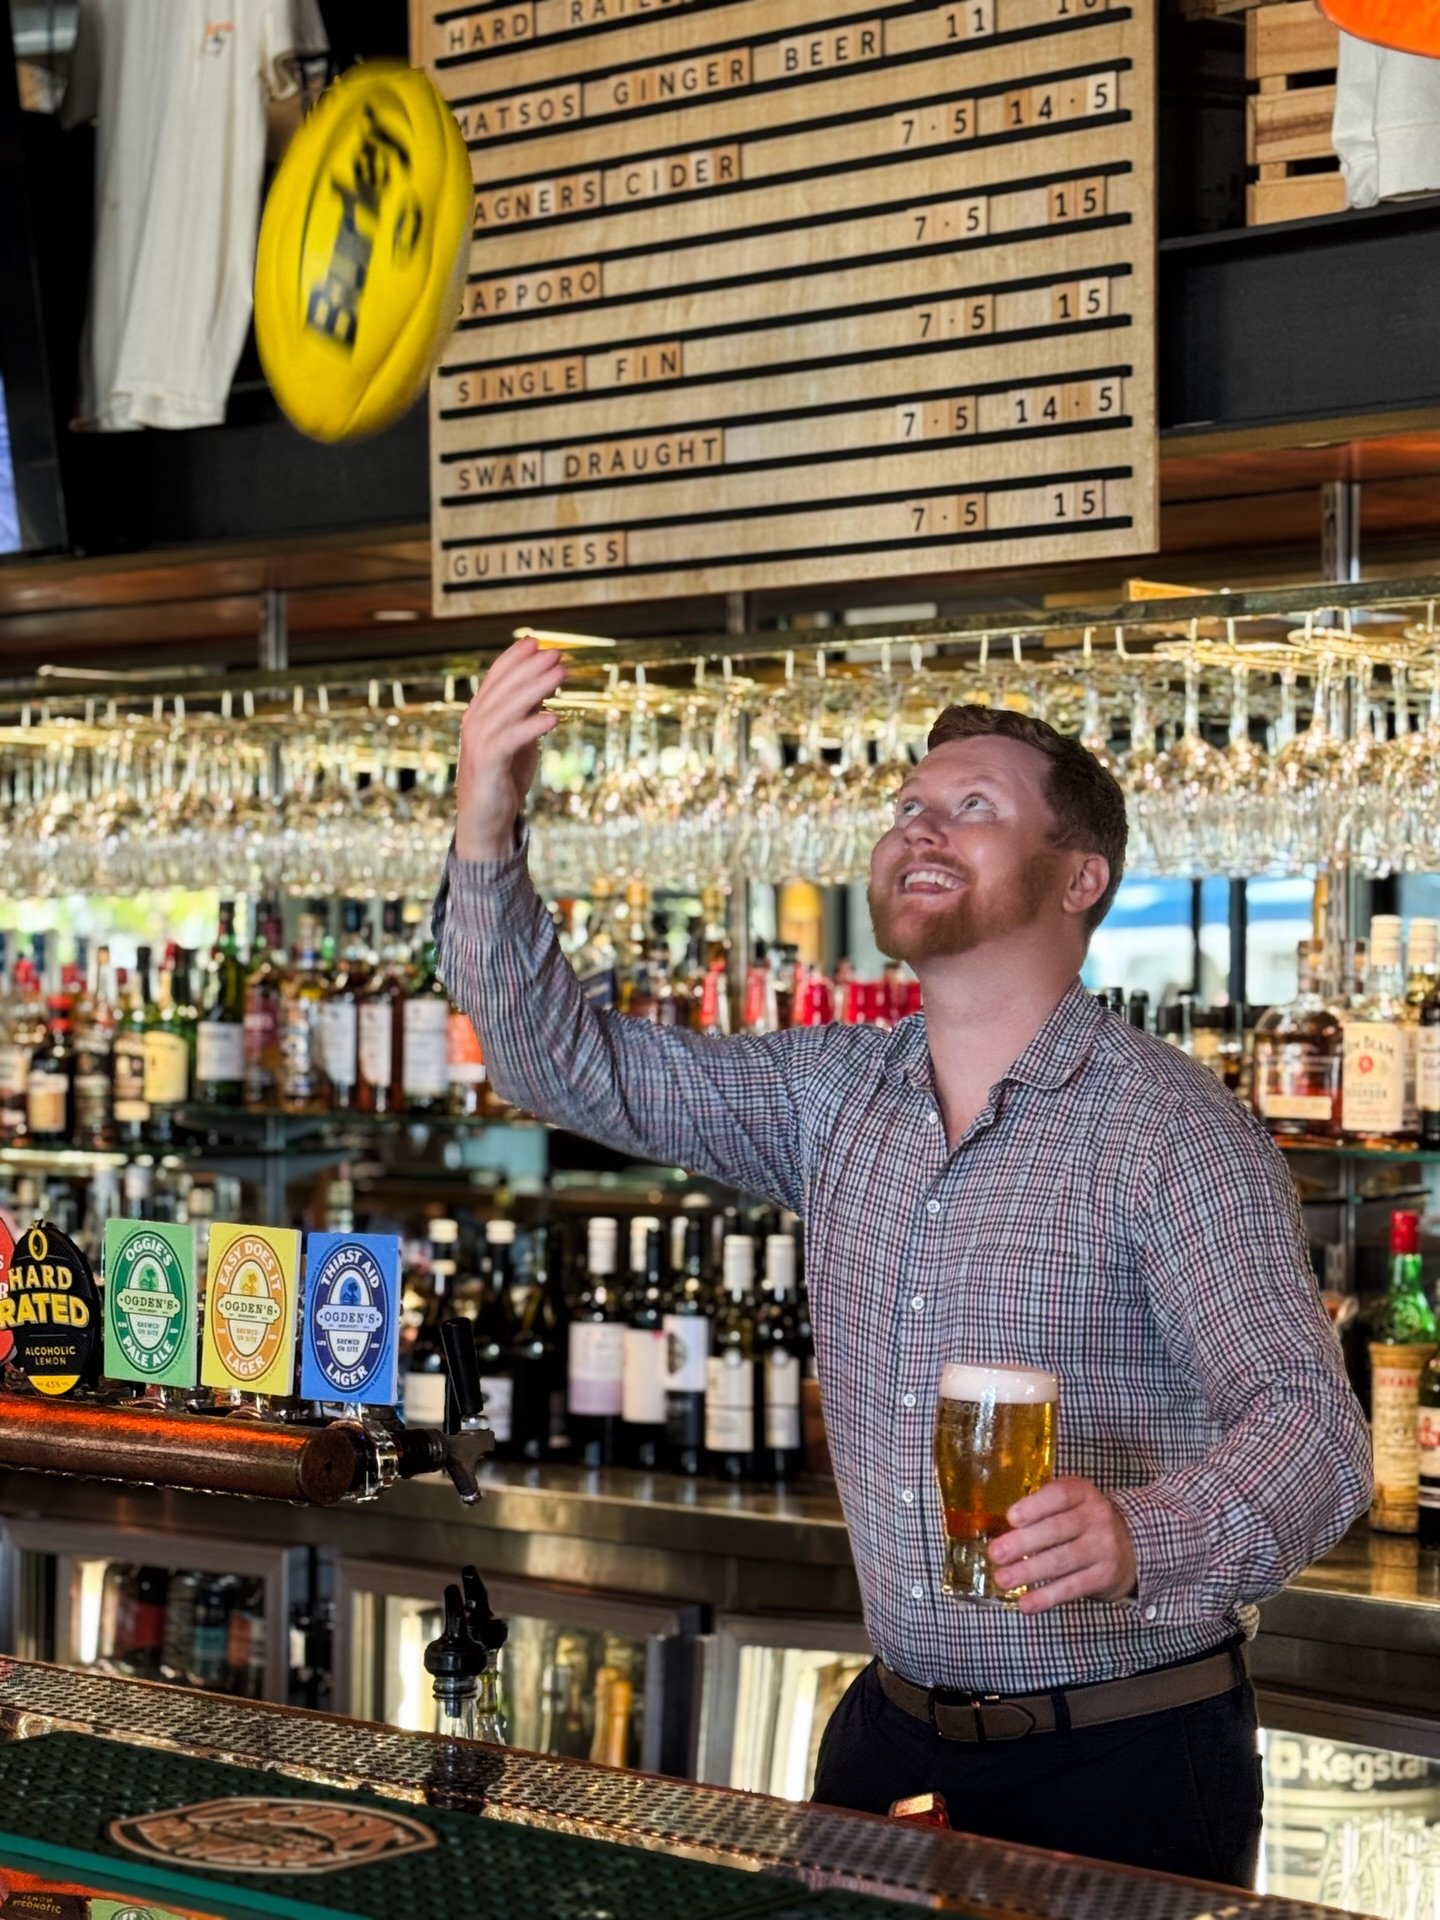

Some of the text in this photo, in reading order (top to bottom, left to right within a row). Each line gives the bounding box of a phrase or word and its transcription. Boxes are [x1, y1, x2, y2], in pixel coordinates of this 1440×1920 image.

[450, 13, 529, 49] HARD
[613, 59, 744, 105] GINGER
[784, 30, 875, 71] BEER
[946, 7, 985, 39] 11
[473, 180, 596, 224] AGNERS
[625, 156, 734, 195] CIDER
[459, 271, 597, 315] APPORO
[1055, 188, 1097, 218] 15
[459, 365, 578, 403] SINGLE
[617, 350, 677, 381] FIN
[1058, 289, 1101, 319] 15
[459, 460, 537, 490] SWAN
[564, 437, 718, 479] DRAUGHT
[454, 540, 619, 577] GUINNESS
[1054, 490, 1096, 517] 15
[125, 1237, 173, 1267] OGGIE'S
[218, 1246, 242, 1287] EASY
[244, 1242, 275, 1271] DOES
[270, 1273, 281, 1290] IT
[8, 1264, 73, 1292] HARD
[320, 1250, 363, 1286] THIRST
[361, 1261, 380, 1289] AID
[0, 1292, 90, 1330] RATED
[124, 1295, 174, 1310] OGDEN'S
[224, 1301, 274, 1316] OGDEN'S
[324, 1311, 375, 1324] OGDEN'S
[25, 1345, 76, 1356] ALCOHOLIC
[122, 1335, 149, 1368] PALE
[152, 1339, 174, 1367] ALE
[336, 1338, 360, 1346] BREWED
[35, 1356, 66, 1366] LEMON
[225, 1350, 265, 1375] LAGER
[326, 1362, 368, 1386] LAGER
